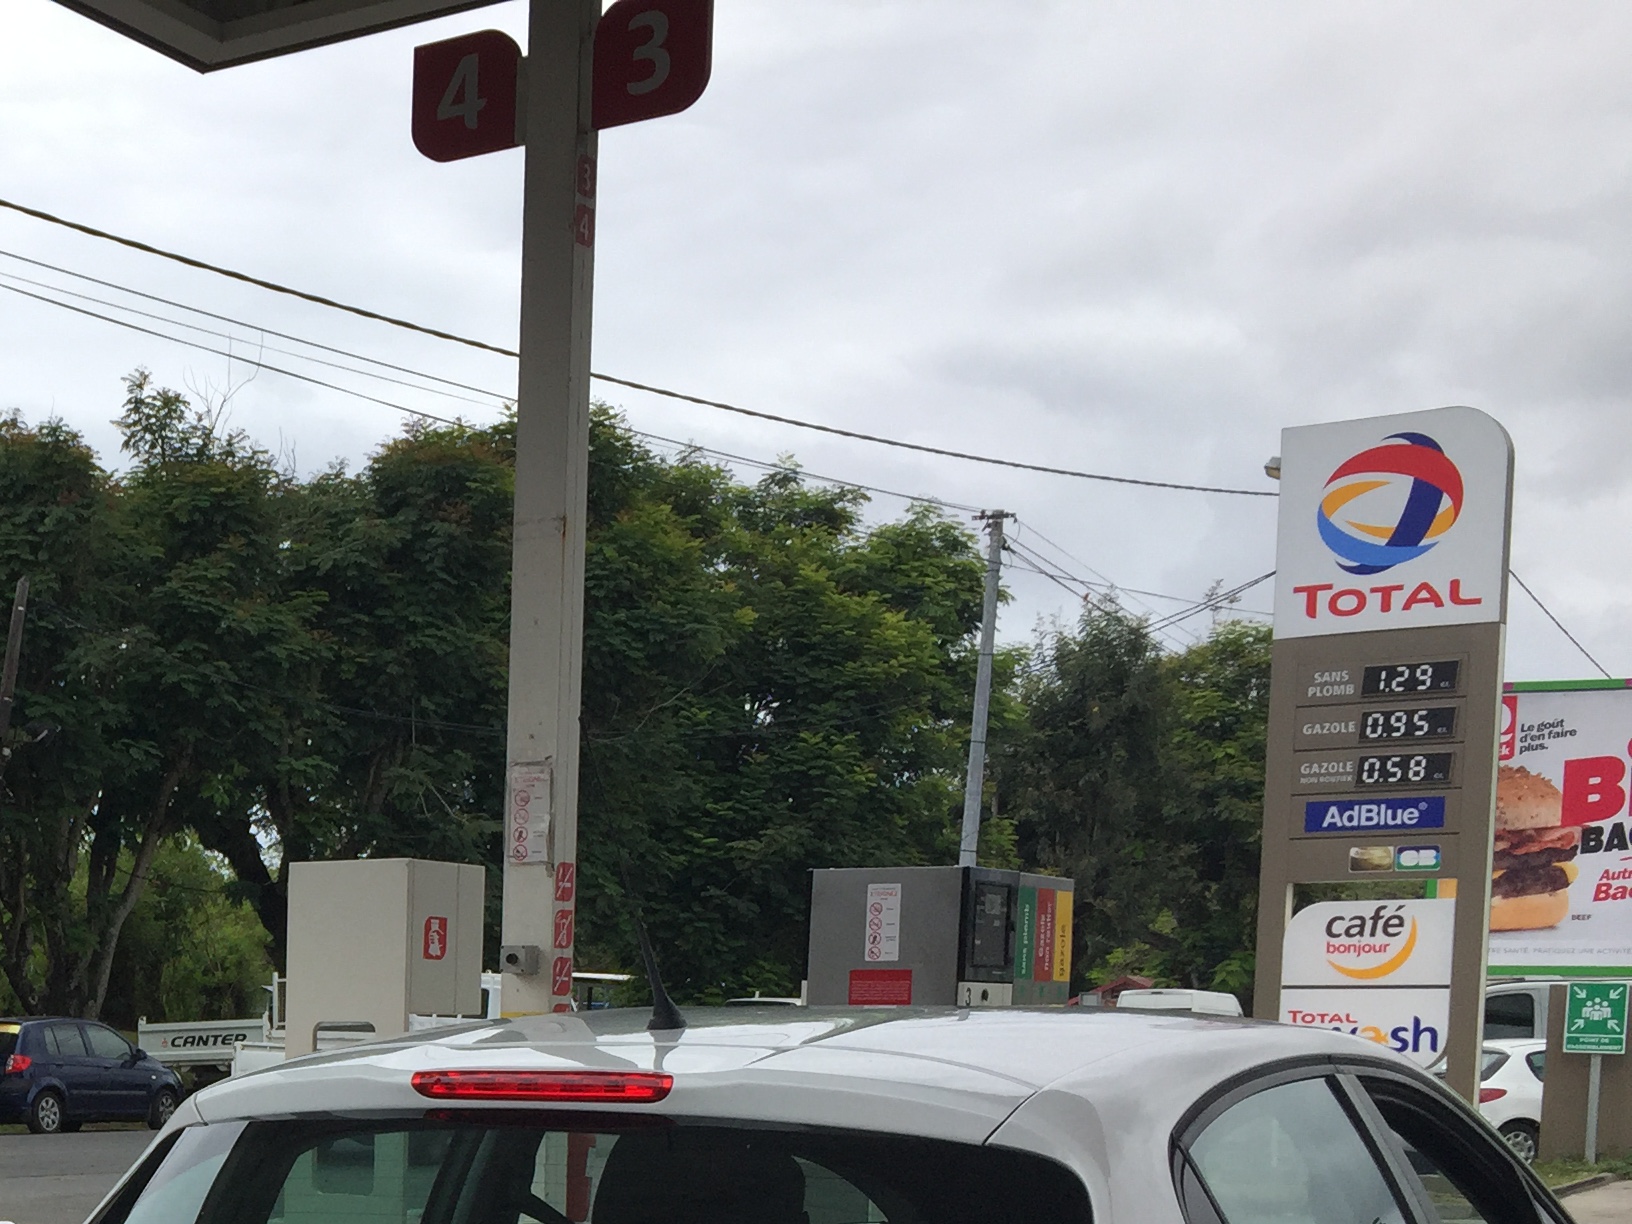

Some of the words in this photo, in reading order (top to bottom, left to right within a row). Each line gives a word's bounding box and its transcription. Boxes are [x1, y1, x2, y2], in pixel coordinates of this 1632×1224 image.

[625, 9, 672, 96] 3
[436, 52, 488, 131] 4
[583, 163, 591, 191] 3
[579, 214, 589, 241] 4
[1292, 578, 1483, 620] TOTAL
[1307, 684, 1355, 698] PLOMB
[1313, 670, 1350, 684] SANS
[1378, 664, 1433, 693] 1.29
[1302, 721, 1357, 735] GAZOLE
[1365, 710, 1429, 738] 0.95
[1519, 732, 1546, 743] d'en
[1547, 727, 1578, 740] faire
[1520, 723, 1535, 733] Le
[1536, 717, 1565, 733] goût
[1519, 742, 1549, 755] plus.
[1300, 760, 1354, 775] GAZOLE
[1361, 755, 1427, 783] 0.58
[1561, 740, 1632, 828] B
[1579, 821, 1632, 855] BA
[1325, 904, 1406, 939] café
[1326, 939, 1391, 958] bonjour
[1287, 1010, 1359, 1025] TOTAL
[1330, 1015, 1439, 1053] ash
